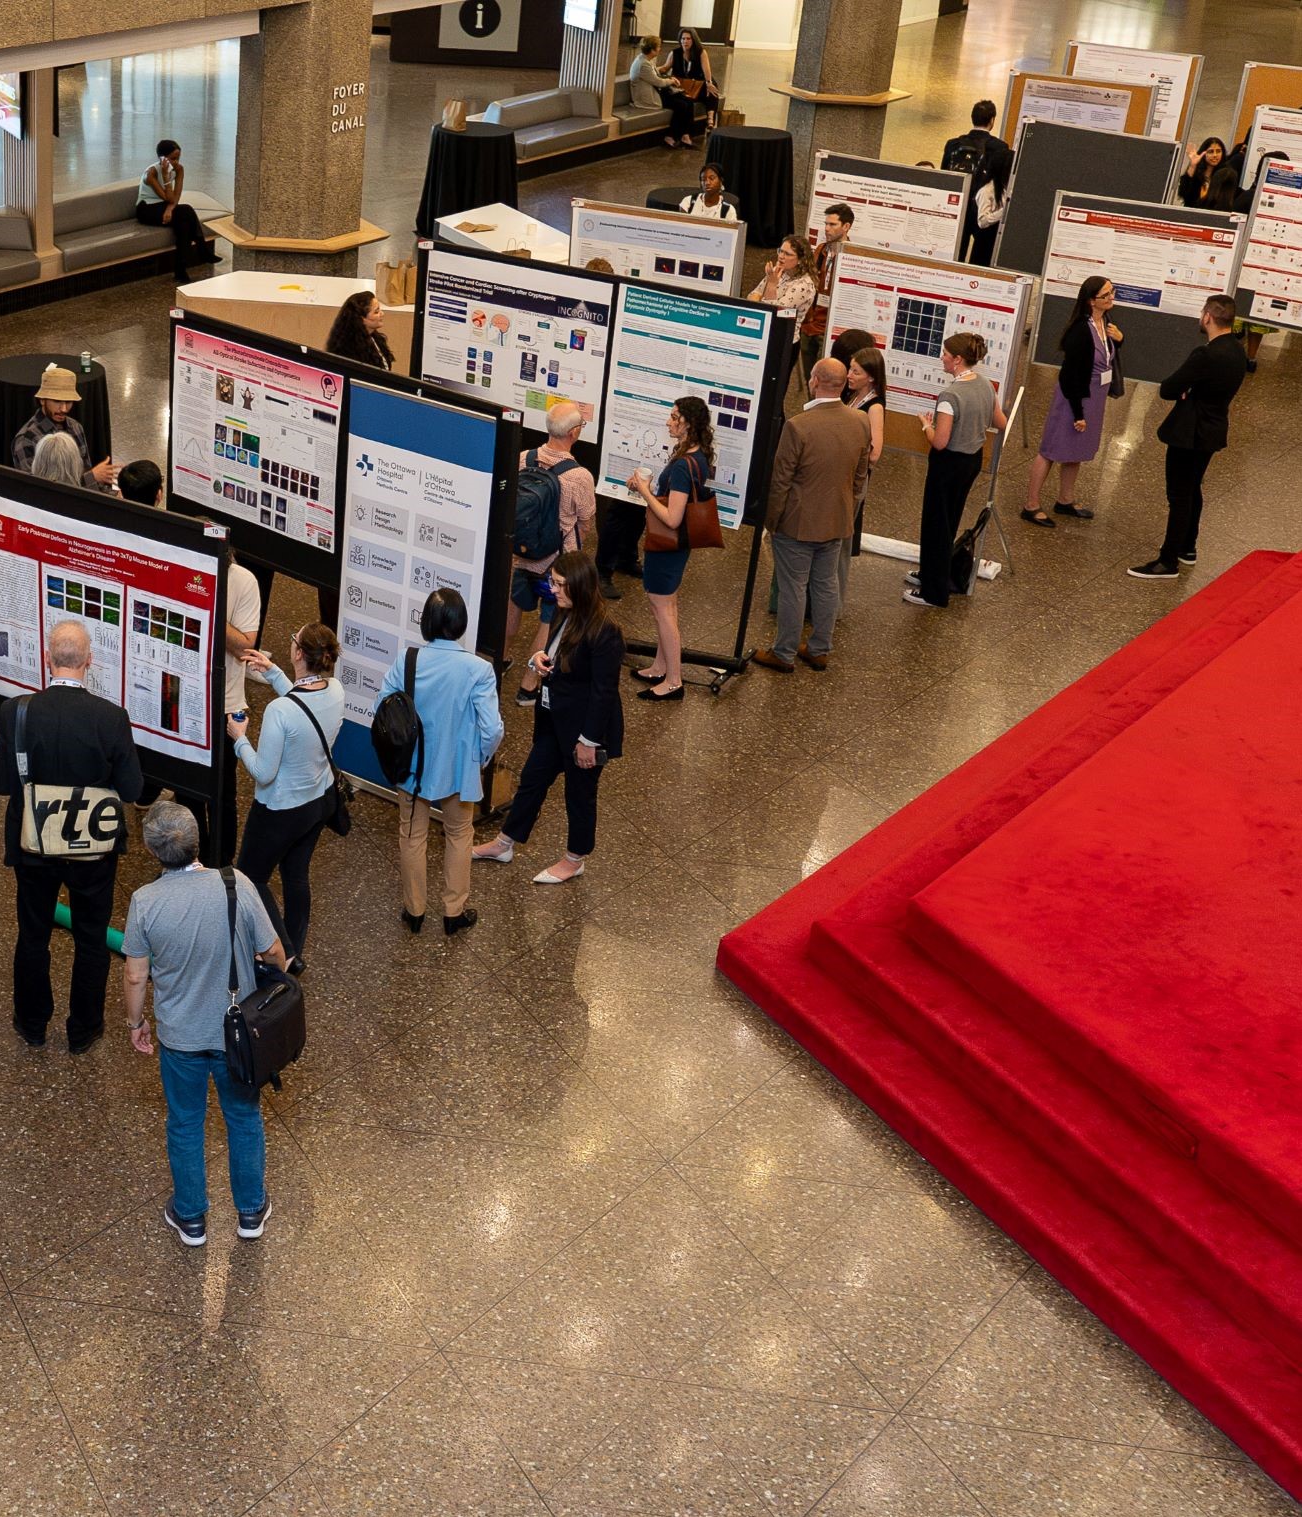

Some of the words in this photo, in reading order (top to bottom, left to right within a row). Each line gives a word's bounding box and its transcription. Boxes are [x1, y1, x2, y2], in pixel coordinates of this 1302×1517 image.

[334, 83, 365, 100] FOYER
[333, 103, 346, 116] DU
[332, 116, 364, 133] CANAL
[842, 255, 863, 264] Assessing
[915, 268, 935, 276] cognitive
[429, 278, 443, 286] Stroke
[454, 283, 482, 293] Randomized
[429, 272, 449, 280] Intensive
[450, 275, 465, 284] Cancer
[475, 280, 493, 289] Cardiac
[493, 284, 515, 295] Screening
[528, 290, 557, 302] Cryptogenic
[628, 291, 642, 299] Patient
[643, 293, 659, 302] Derived
[659, 297, 674, 305] Cellular
[675, 300, 690, 308] Models
[558, 305, 604, 323] INCOGNITO
[669, 304, 688, 314] Cognitive
[688, 309, 705, 317] Decline
[234, 355, 246, 364] Stroke
[378, 458, 390, 468] The
[391, 463, 416, 475] Ottawa
[377, 475, 393, 484] Ottawa
[378, 467, 403, 480] Hospital
[425, 472, 453, 486] L'Hôpital
[376, 482, 393, 491] Methods
[394, 486, 408, 495] Centre
[424, 489, 438, 497] Centre
[425, 482, 456, 496] d'Ottawa
[375, 514, 390, 524] Design
[376, 508, 397, 519] Research
[374, 521, 404, 535] Methodology
[440, 533, 457, 542] Clinical
[440, 540, 452, 548] Trials
[18, 524, 29, 535] Early
[30, 528, 50, 539] Postnatal
[50, 533, 68, 545] Defects
[68, 537, 73, 546] in
[73, 539, 105, 556] Neurogenesis
[111, 549, 120, 559] the
[133, 554, 147, 567] Mouse
[148, 560, 163, 570] Model
[69, 547, 95, 560] Alzheimer's
[96, 553, 116, 563] Disease
[371, 554, 397, 566] Knowledge
[371, 560, 393, 572] Synthesis
[436, 575, 462, 588] Knowledge
[368, 597, 396, 610] Biostatistics
[366, 636, 380, 645] Health
[365, 642, 389, 654] Economics
[363, 675, 374, 683] Data
[35, 797, 121, 841] rte
